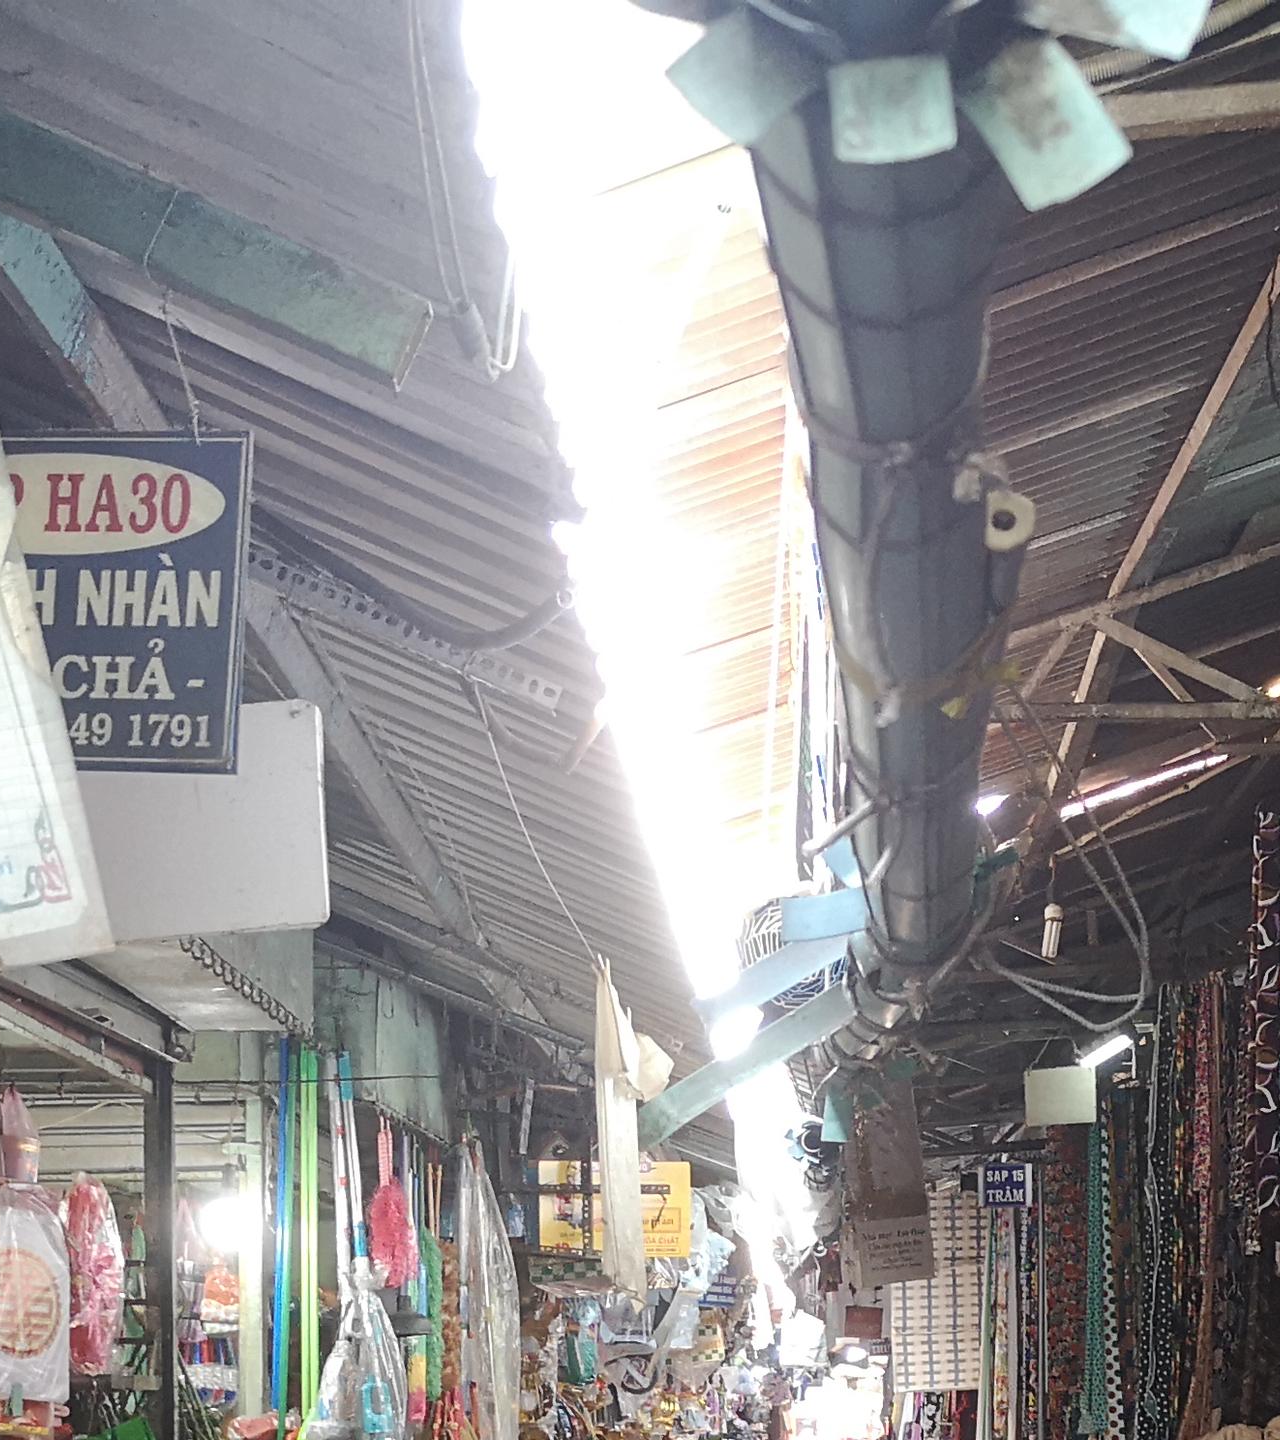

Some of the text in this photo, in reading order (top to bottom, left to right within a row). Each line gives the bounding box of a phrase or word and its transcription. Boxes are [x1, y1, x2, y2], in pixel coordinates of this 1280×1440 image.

[43, 472, 193, 533] HA30
[75, 552, 222, 628] NHÀN
[51, 638, 175, 700] CHẢ
[126, 713, 212, 748] 1791
[1011, 1169, 1024, 1182] 15
